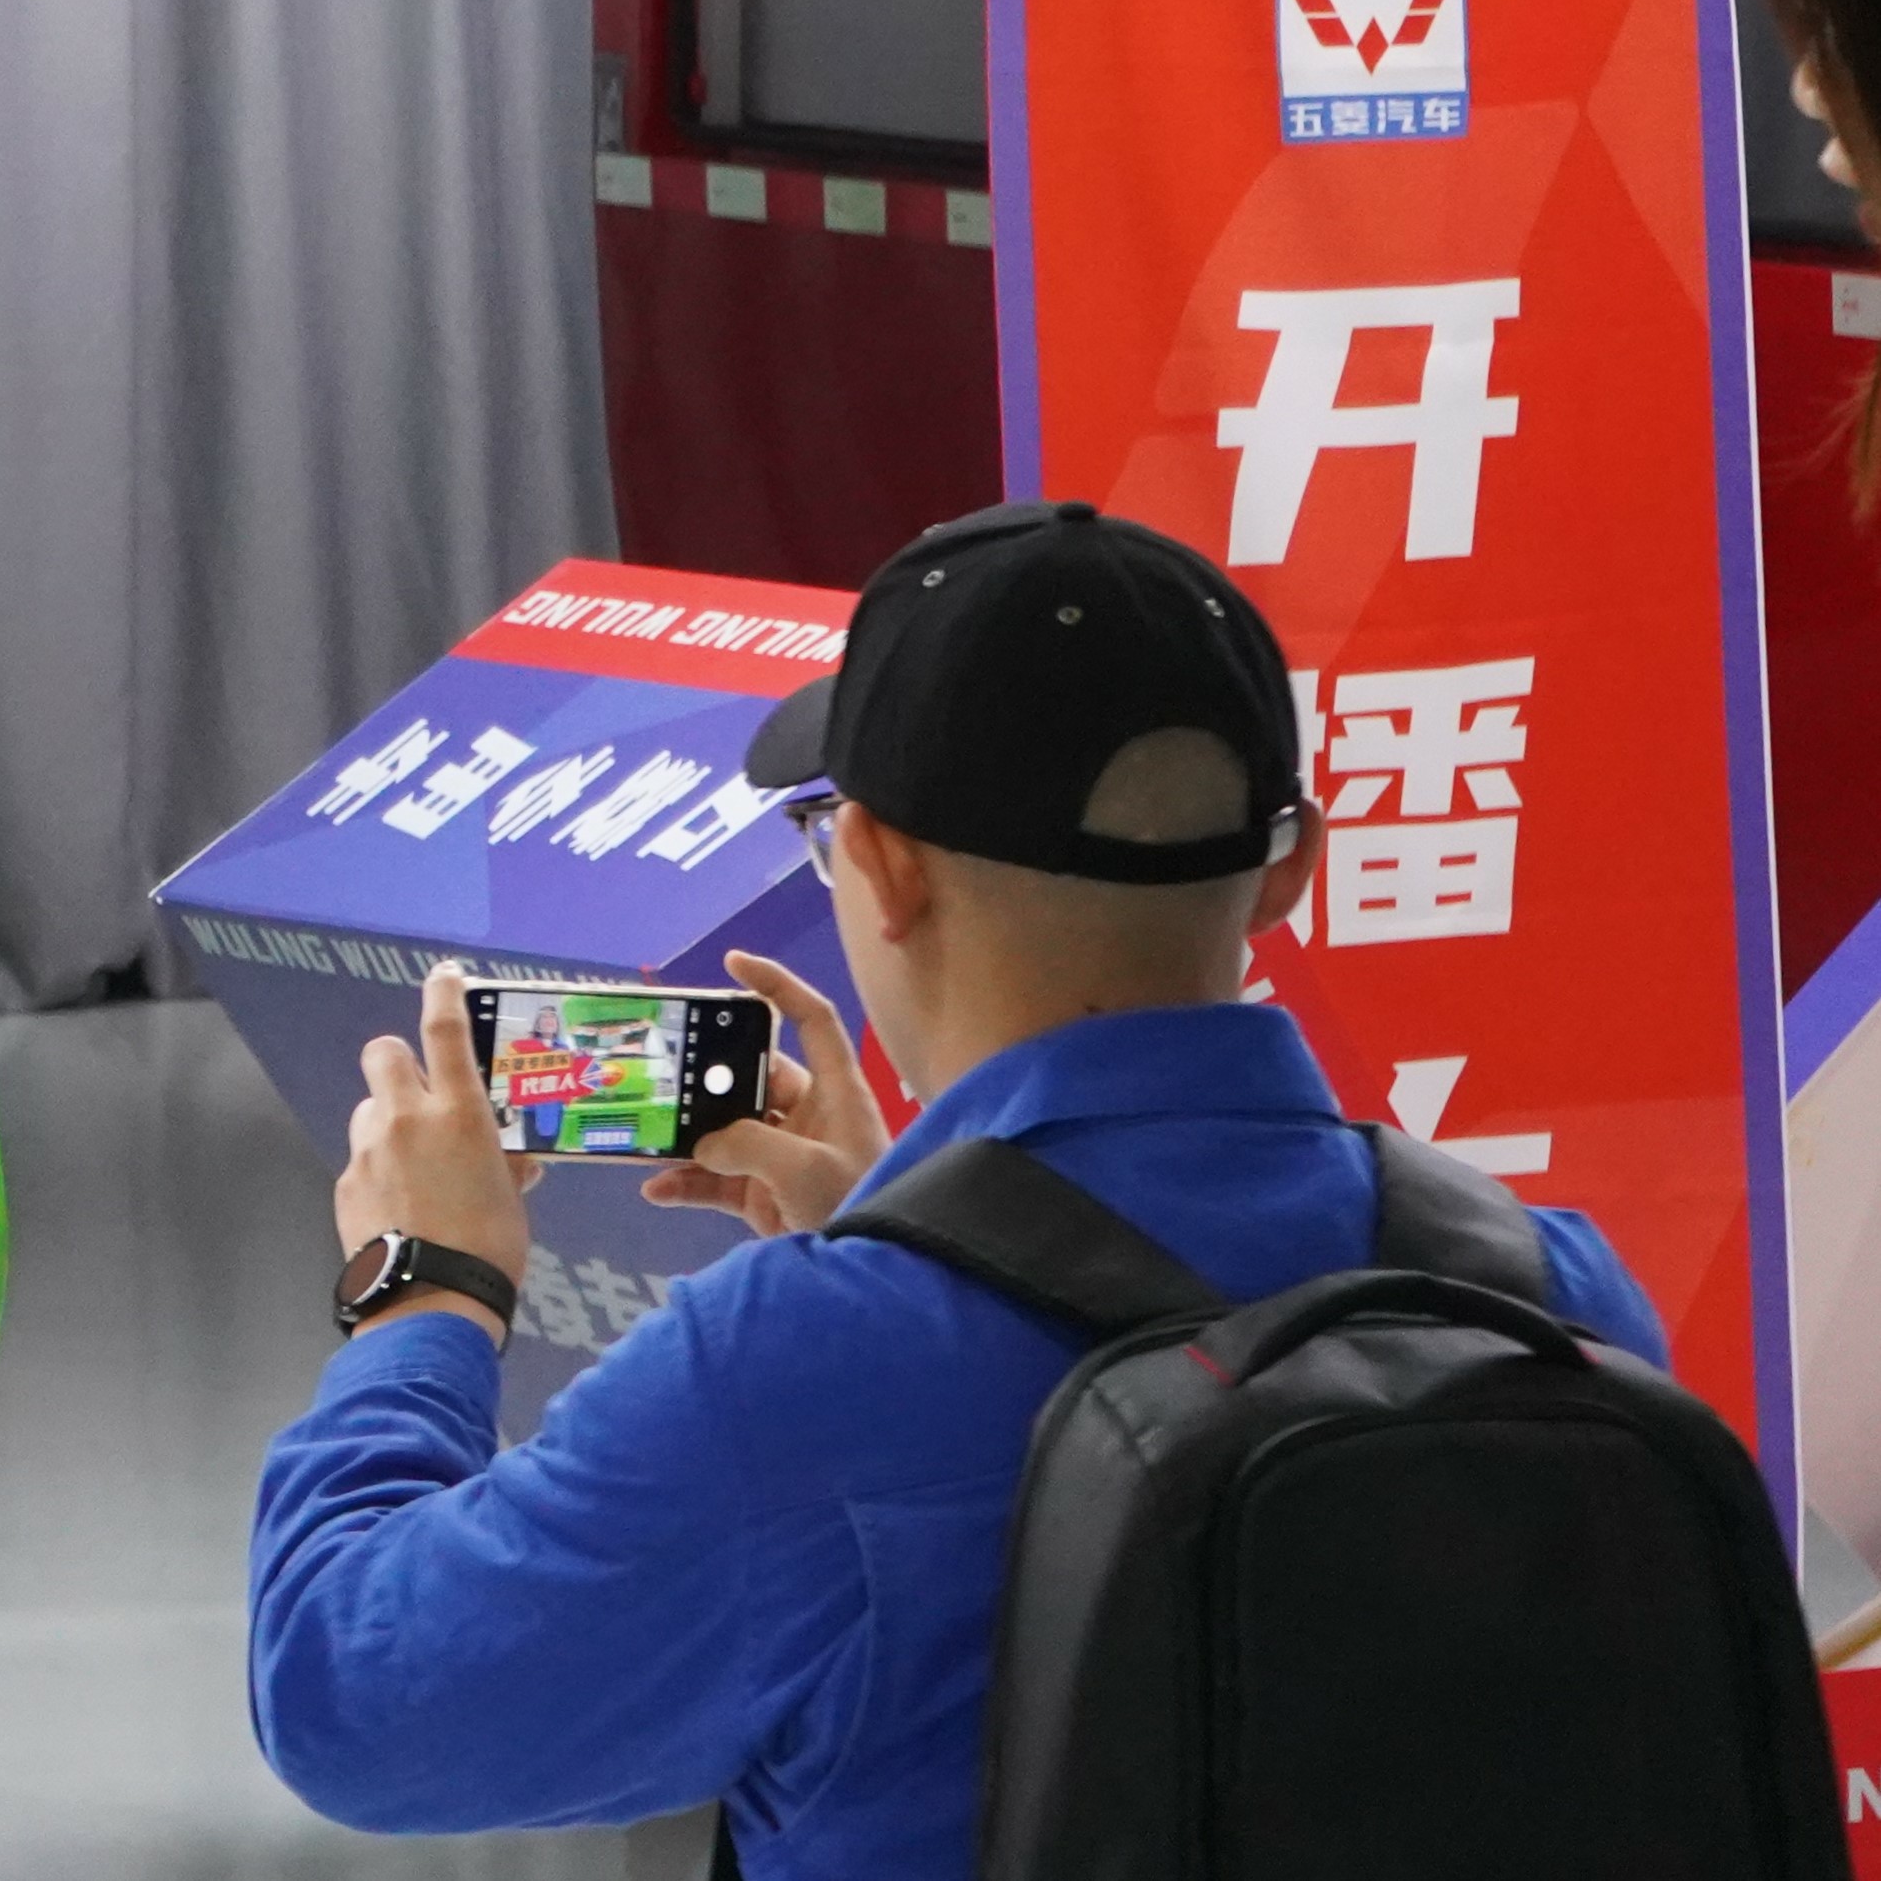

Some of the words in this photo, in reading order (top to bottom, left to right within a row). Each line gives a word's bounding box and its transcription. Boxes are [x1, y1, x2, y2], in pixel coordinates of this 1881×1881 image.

[1288, 97, 1460, 137] 五菱汽车
[502, 589, 686, 640] WULING
[181, 914, 337, 975] WULING
